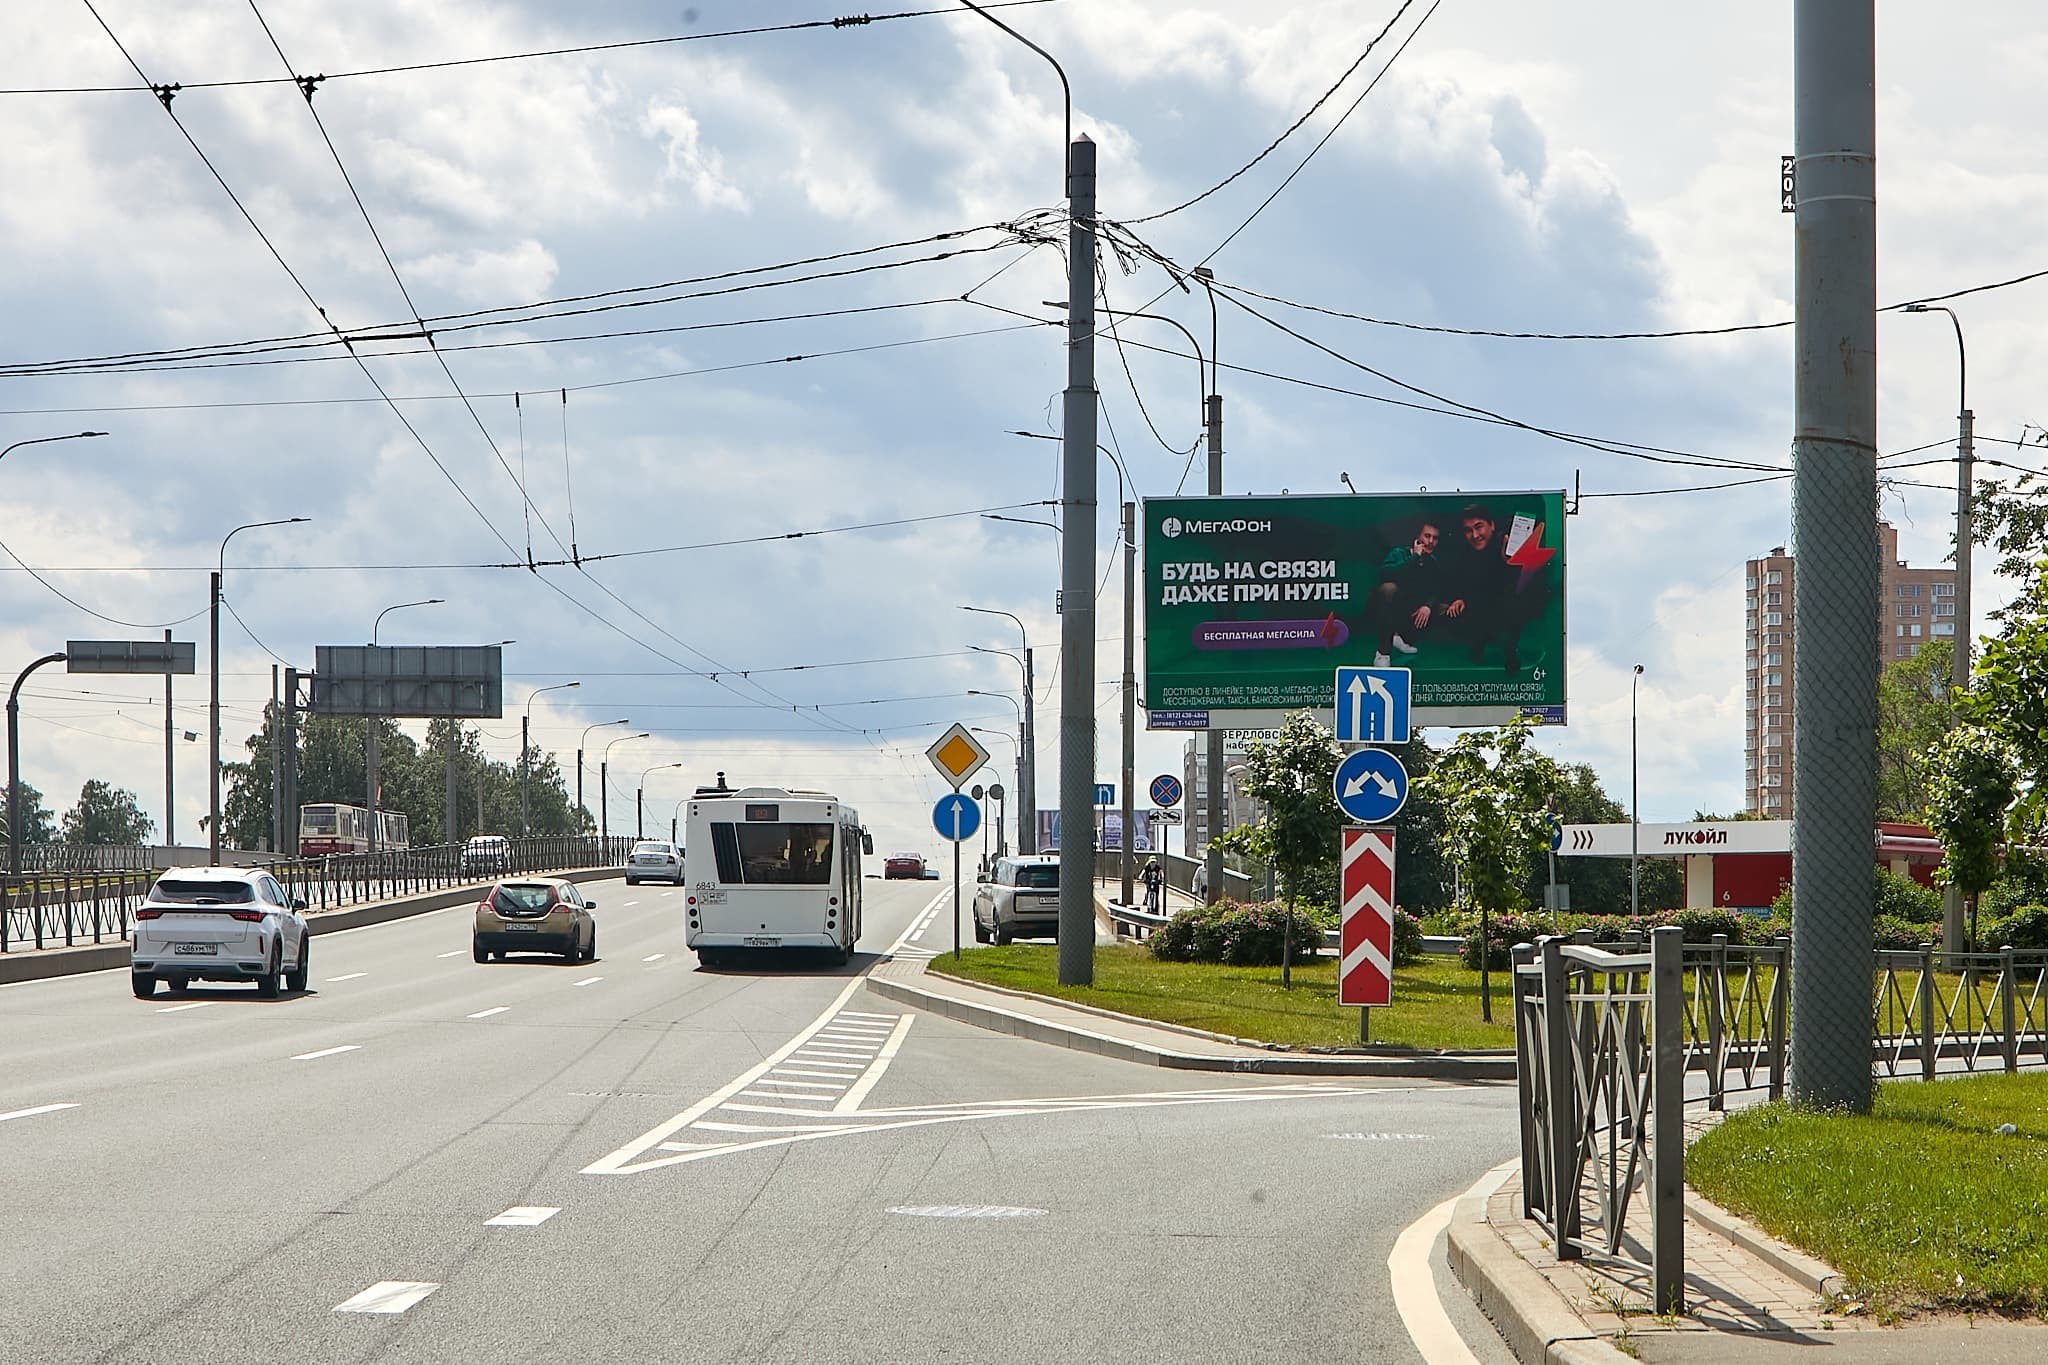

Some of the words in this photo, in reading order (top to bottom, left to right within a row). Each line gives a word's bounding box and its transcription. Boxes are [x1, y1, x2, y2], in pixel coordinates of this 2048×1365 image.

[1783, 159, 1793, 210] 204
[1162, 563, 1220, 583] БУДЬ
[1224, 562, 1256, 579] НА
[1259, 560, 1336, 578] СВЯЗИ
[1161, 585, 1228, 605] ДАЖЕ
[1233, 584, 1279, 602] ПРИ
[1284, 583, 1349, 600] НУЛЕ!
[1204, 632, 1265, 641] БЕСПЛАТНАЯ
[1266, 630, 1315, 639] МЕГАСИЛА
[1533, 667, 1547, 681] 6+
[1162, 687, 1203, 697] ДОСТУПНО
[1205, 687, 1211, 695] В
[1212, 686, 1244, 695] ЛИНЕЙКЕ
[1246, 686, 1279, 695] ТАРИФОВ
[1281, 686, 1318, 694] «МЕГАФОН
[1422, 684, 1479, 693] ПОЛЬЗОВАТЬСЯ
[1481, 684, 1519, 692] УСЛУГАМИ
[1520, 684, 1546, 692] СВЯЗИ,
[1252, 693, 1303, 704] БАНКОВСКИМИ
[1436, 692, 1489, 703] ПОДРОБНОСТИ
[1490, 692, 1500, 701] НА
[1501, 692, 1545, 701] MEGAFON.RU
[1223, 730, 1283, 739] ВЕРДЛОВС
[1664, 828, 1727, 845] ЛУКОЙЛ
[696, 882, 715, 890] 6843
[1723, 891, 1730, 901] 6
